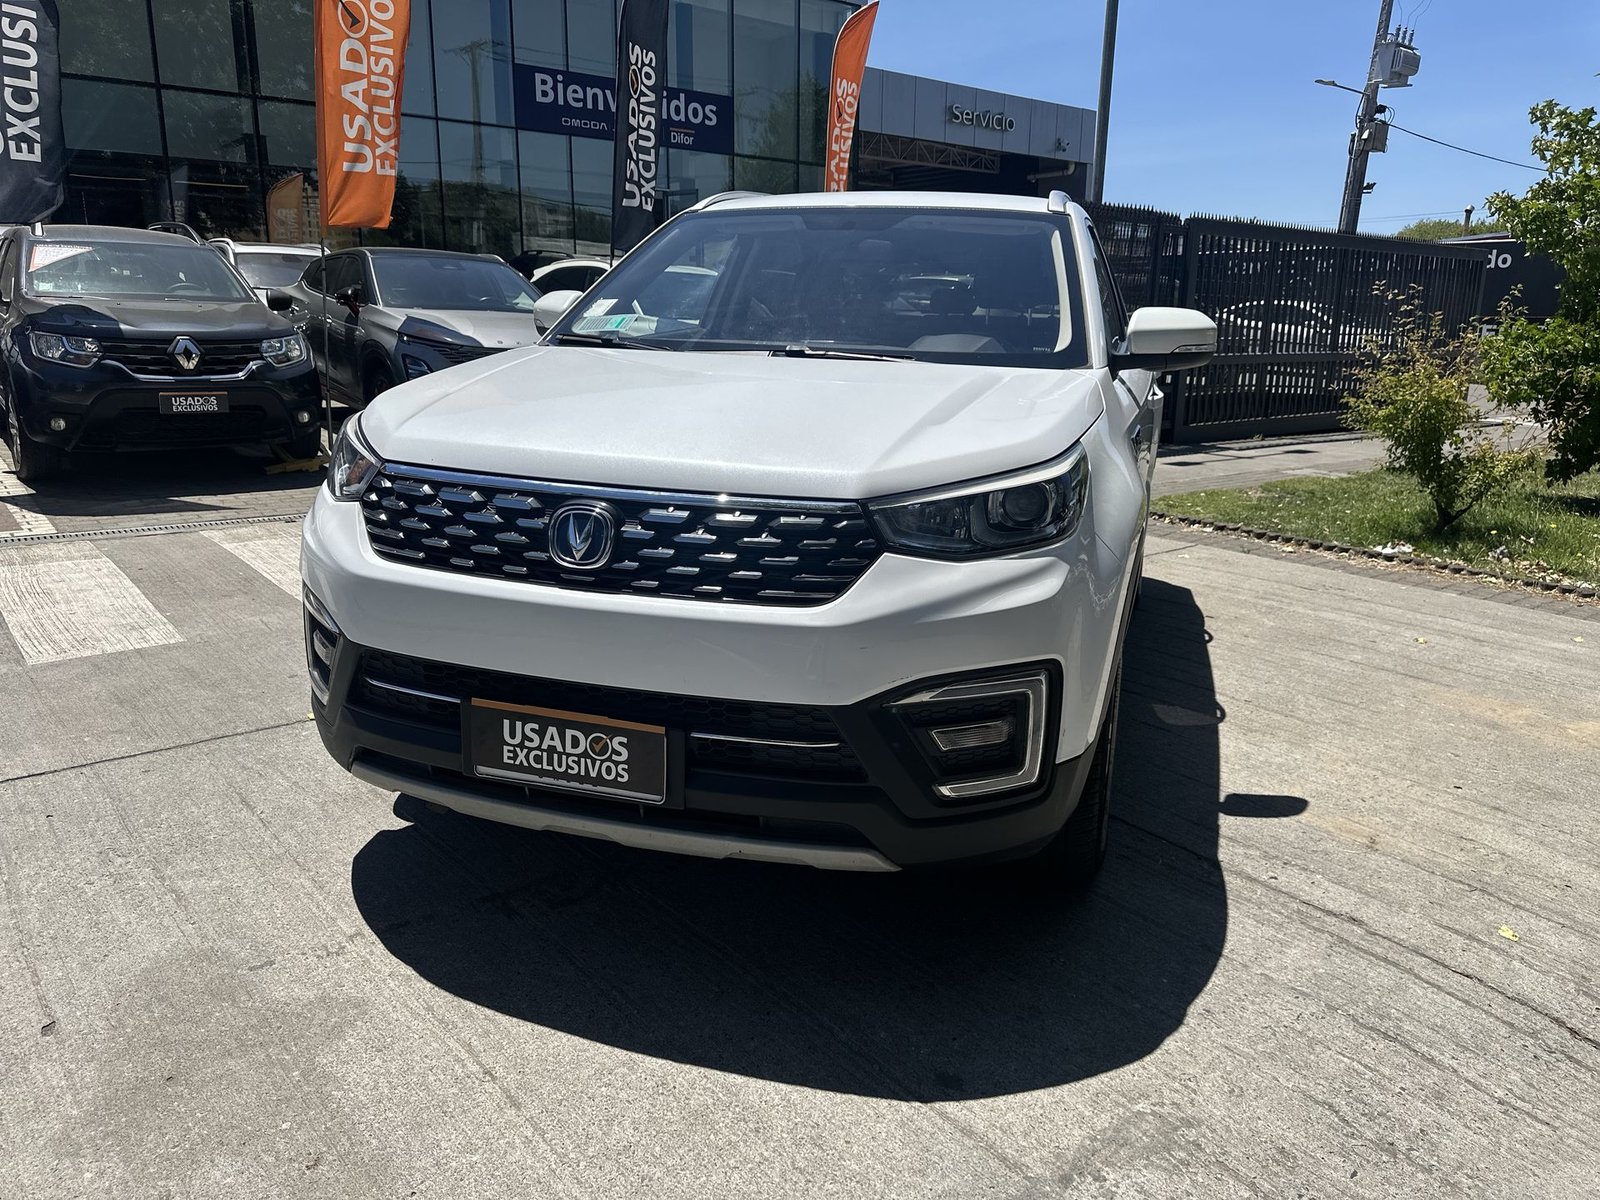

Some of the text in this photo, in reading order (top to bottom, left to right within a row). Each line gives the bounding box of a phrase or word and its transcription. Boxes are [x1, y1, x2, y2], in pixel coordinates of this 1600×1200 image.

[1, 3, 42, 163] EXCLUSI
[622, 42, 642, 208] USADOS
[638, 50, 657, 212] EXCLUSIVOS
[952, 104, 1016, 132] Servicio
[670, 130, 695, 146] Difor
[171, 396, 217, 406] USADOS
[172, 404, 218, 412] EXCLUSIVOS
[502, 718, 629, 762] USADOS
[502, 745, 630, 783] EXCLUSIVOS
